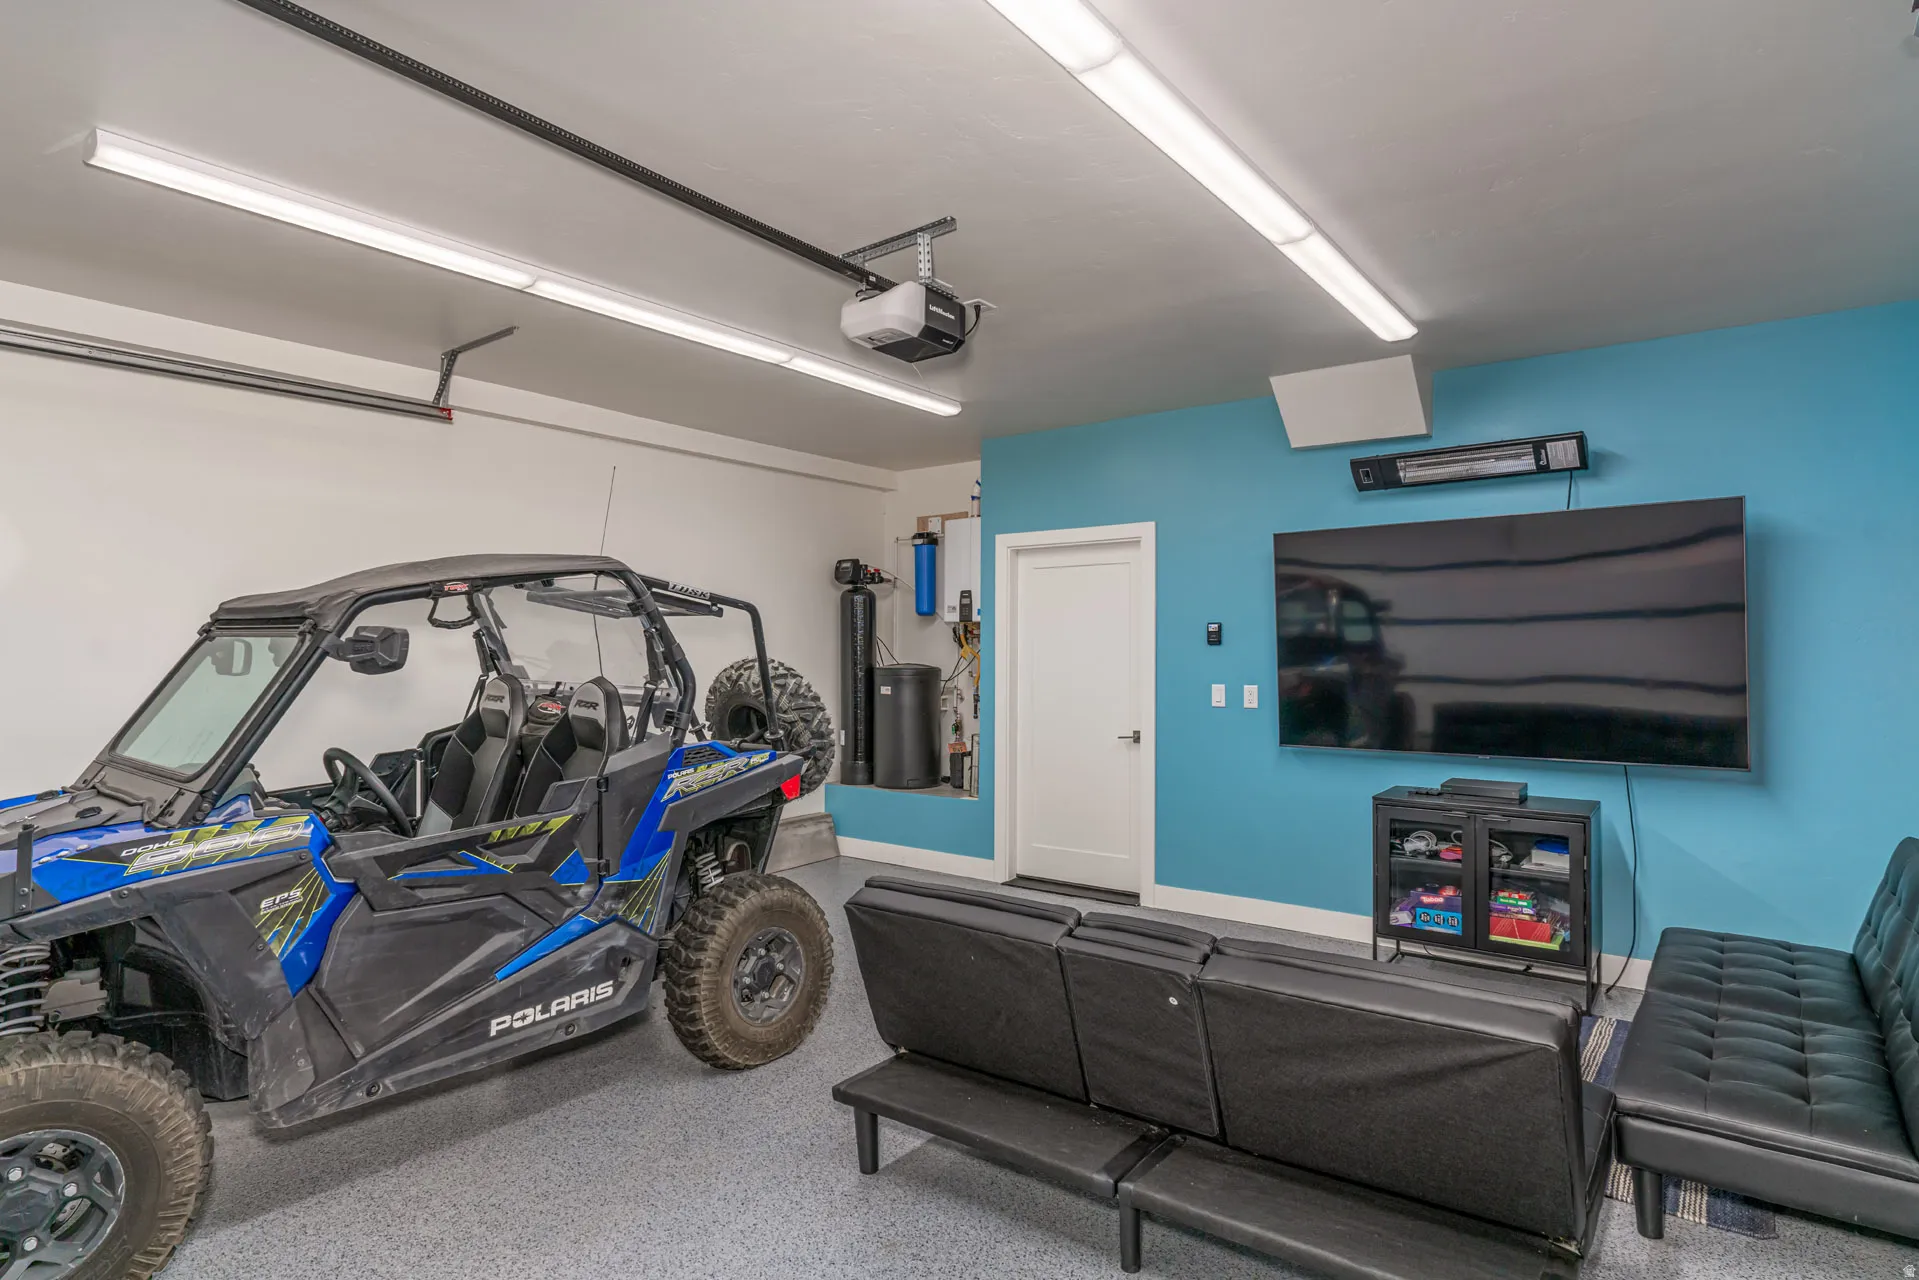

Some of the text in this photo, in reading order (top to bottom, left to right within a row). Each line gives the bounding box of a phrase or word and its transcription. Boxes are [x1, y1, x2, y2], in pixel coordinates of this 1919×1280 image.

[671, 584, 709, 598] TUSK
[485, 694, 505, 704] RZR
[574, 699, 599, 711] RZR
[661, 757, 749, 802] RZR
[667, 768, 695, 780] POLARIS
[120, 838, 183, 857] DOHC
[124, 821, 304, 876] 900
[260, 888, 302, 909] EPS
[490, 980, 614, 1037] POLARIS
